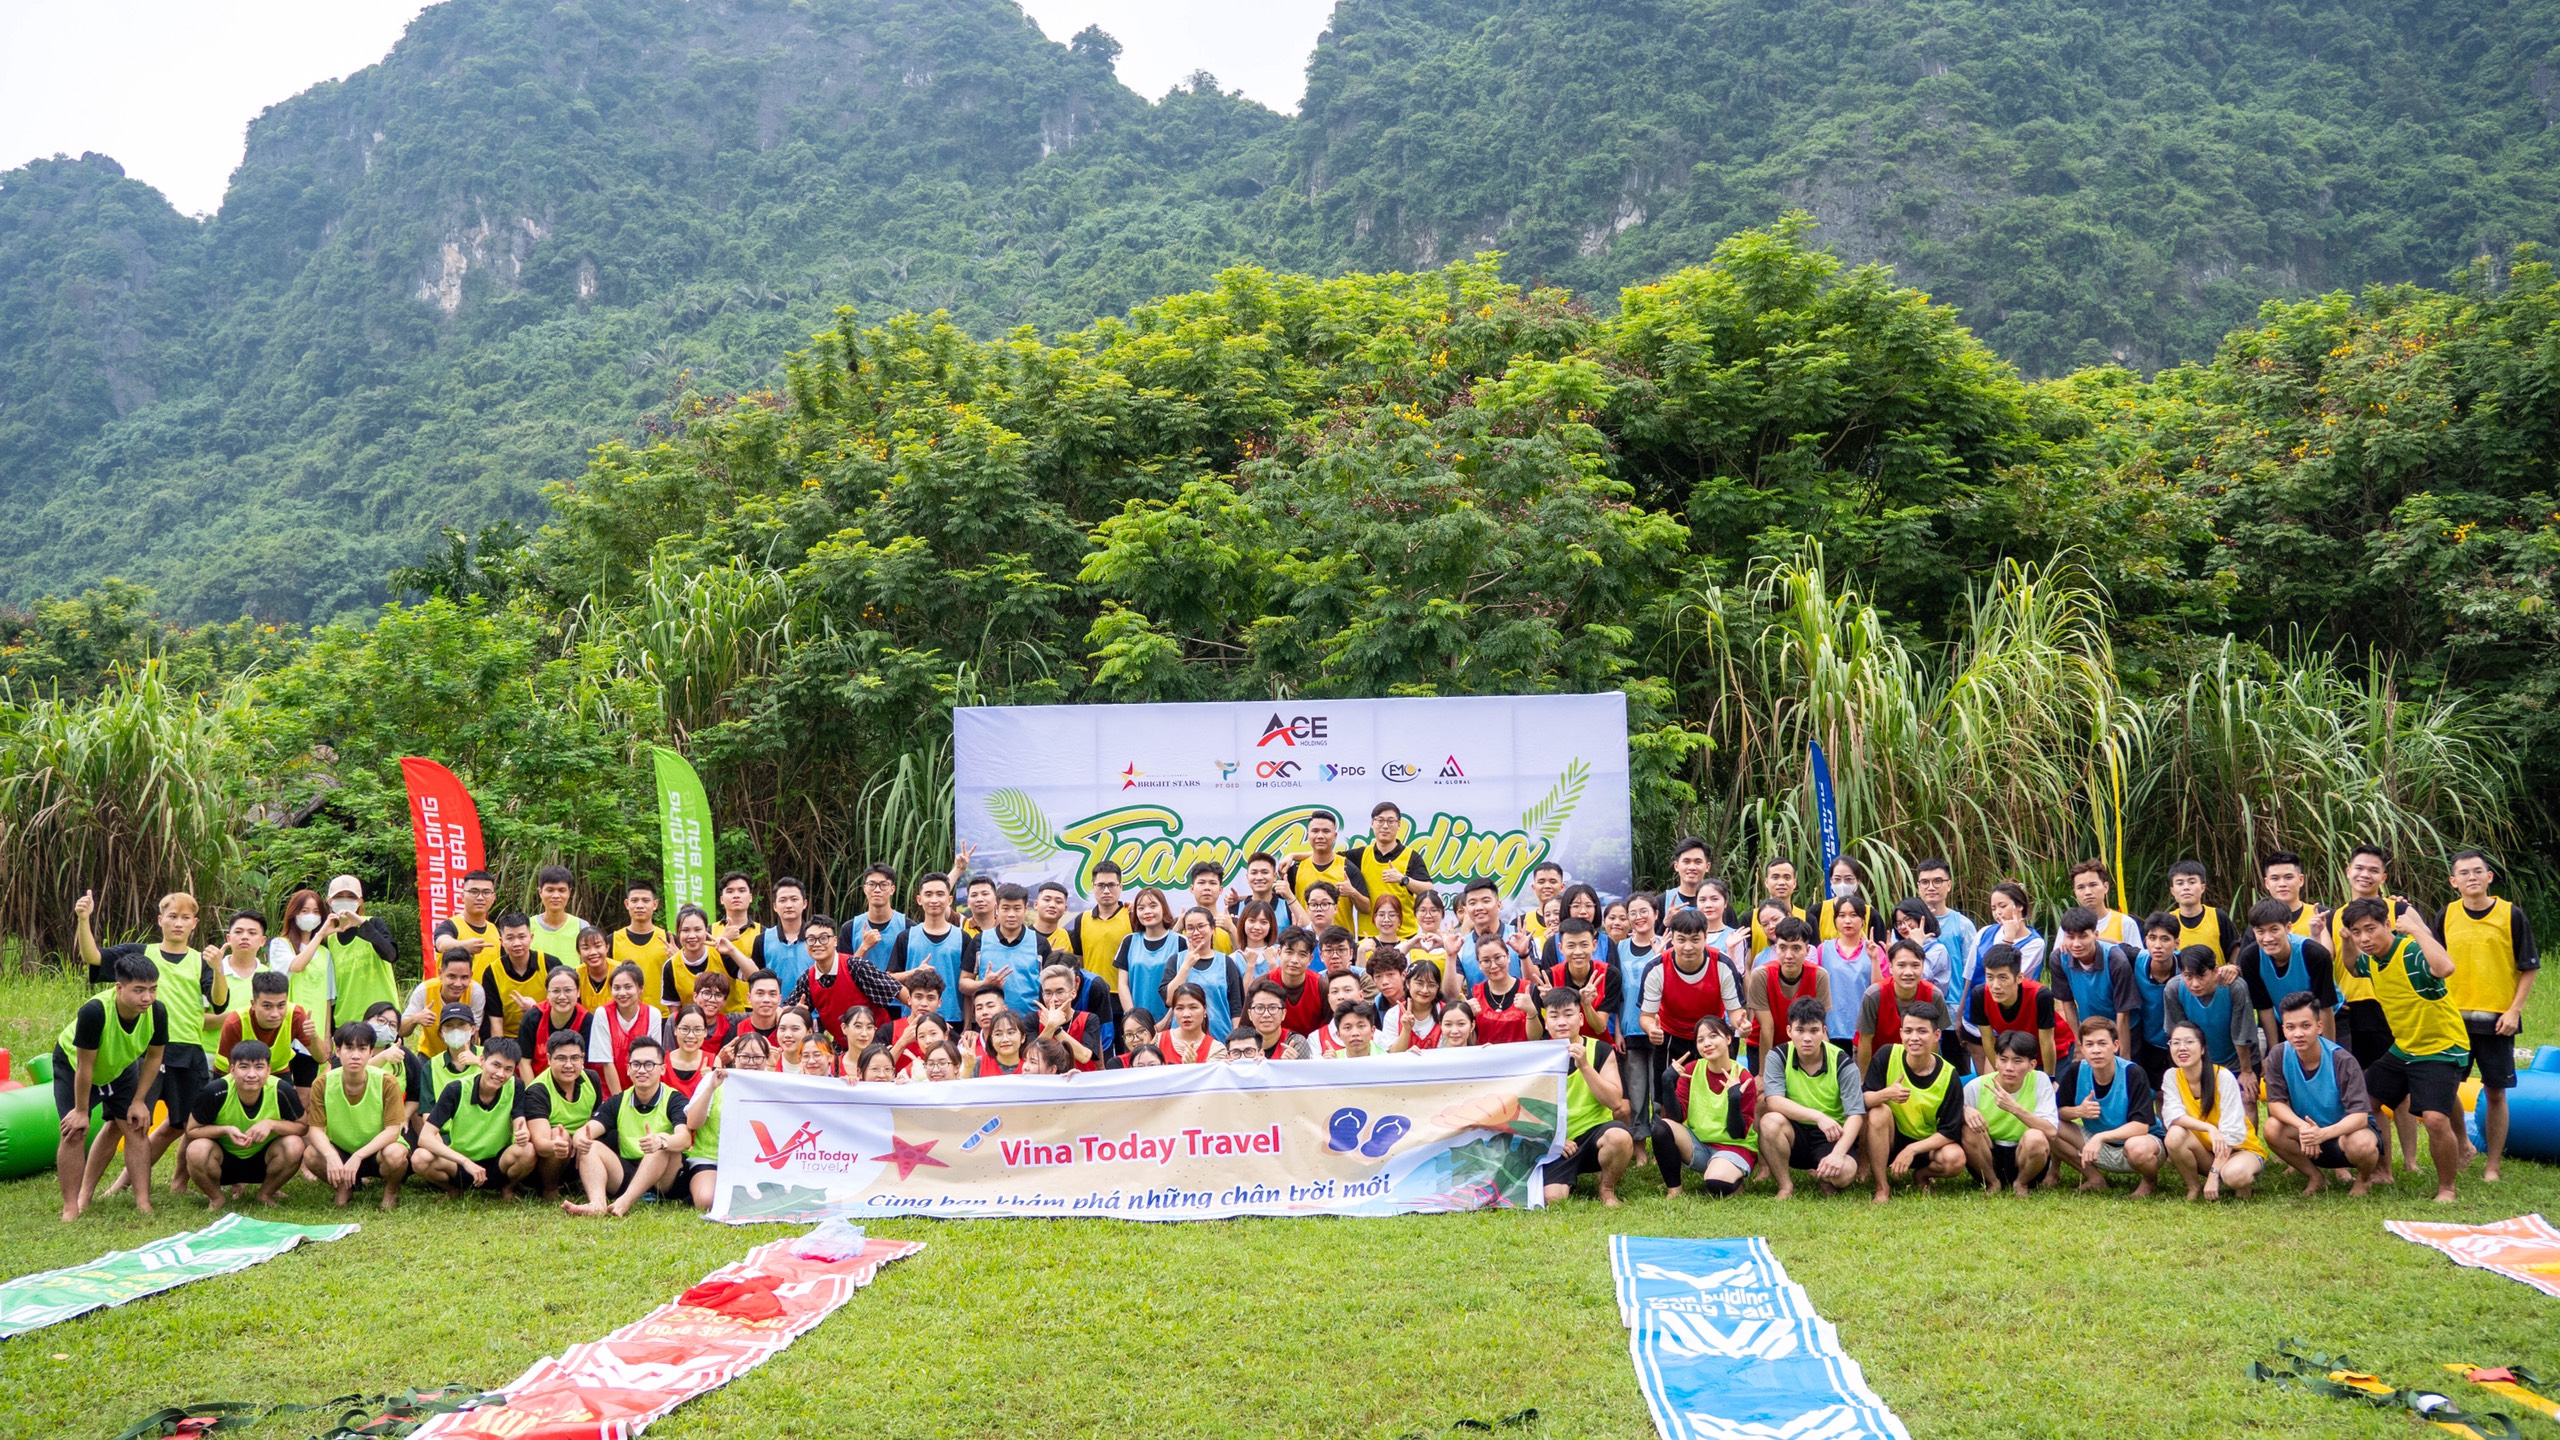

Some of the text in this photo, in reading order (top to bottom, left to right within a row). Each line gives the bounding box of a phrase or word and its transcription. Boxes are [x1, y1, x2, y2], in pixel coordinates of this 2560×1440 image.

[1256, 712, 1328, 747] ACE
[1340, 766, 1366, 776] PDG
[1137, 779, 1201, 789] BRIGHT STARS
[1270, 780, 1302, 788] GLOBAL
[1055, 804, 1241, 900] Team
[1000, 1125, 1281, 1166] Vina Today Travel
[819, 1150, 859, 1163] Today
[801, 1160, 840, 1172] Travel
[867, 1194, 933, 1209] Cùng
[1072, 1190, 1121, 1209] phá
[1220, 1183, 1281, 1206] chân
[1289, 1179, 1335, 1202] trời
[1342, 1173, 1392, 1198] mới
